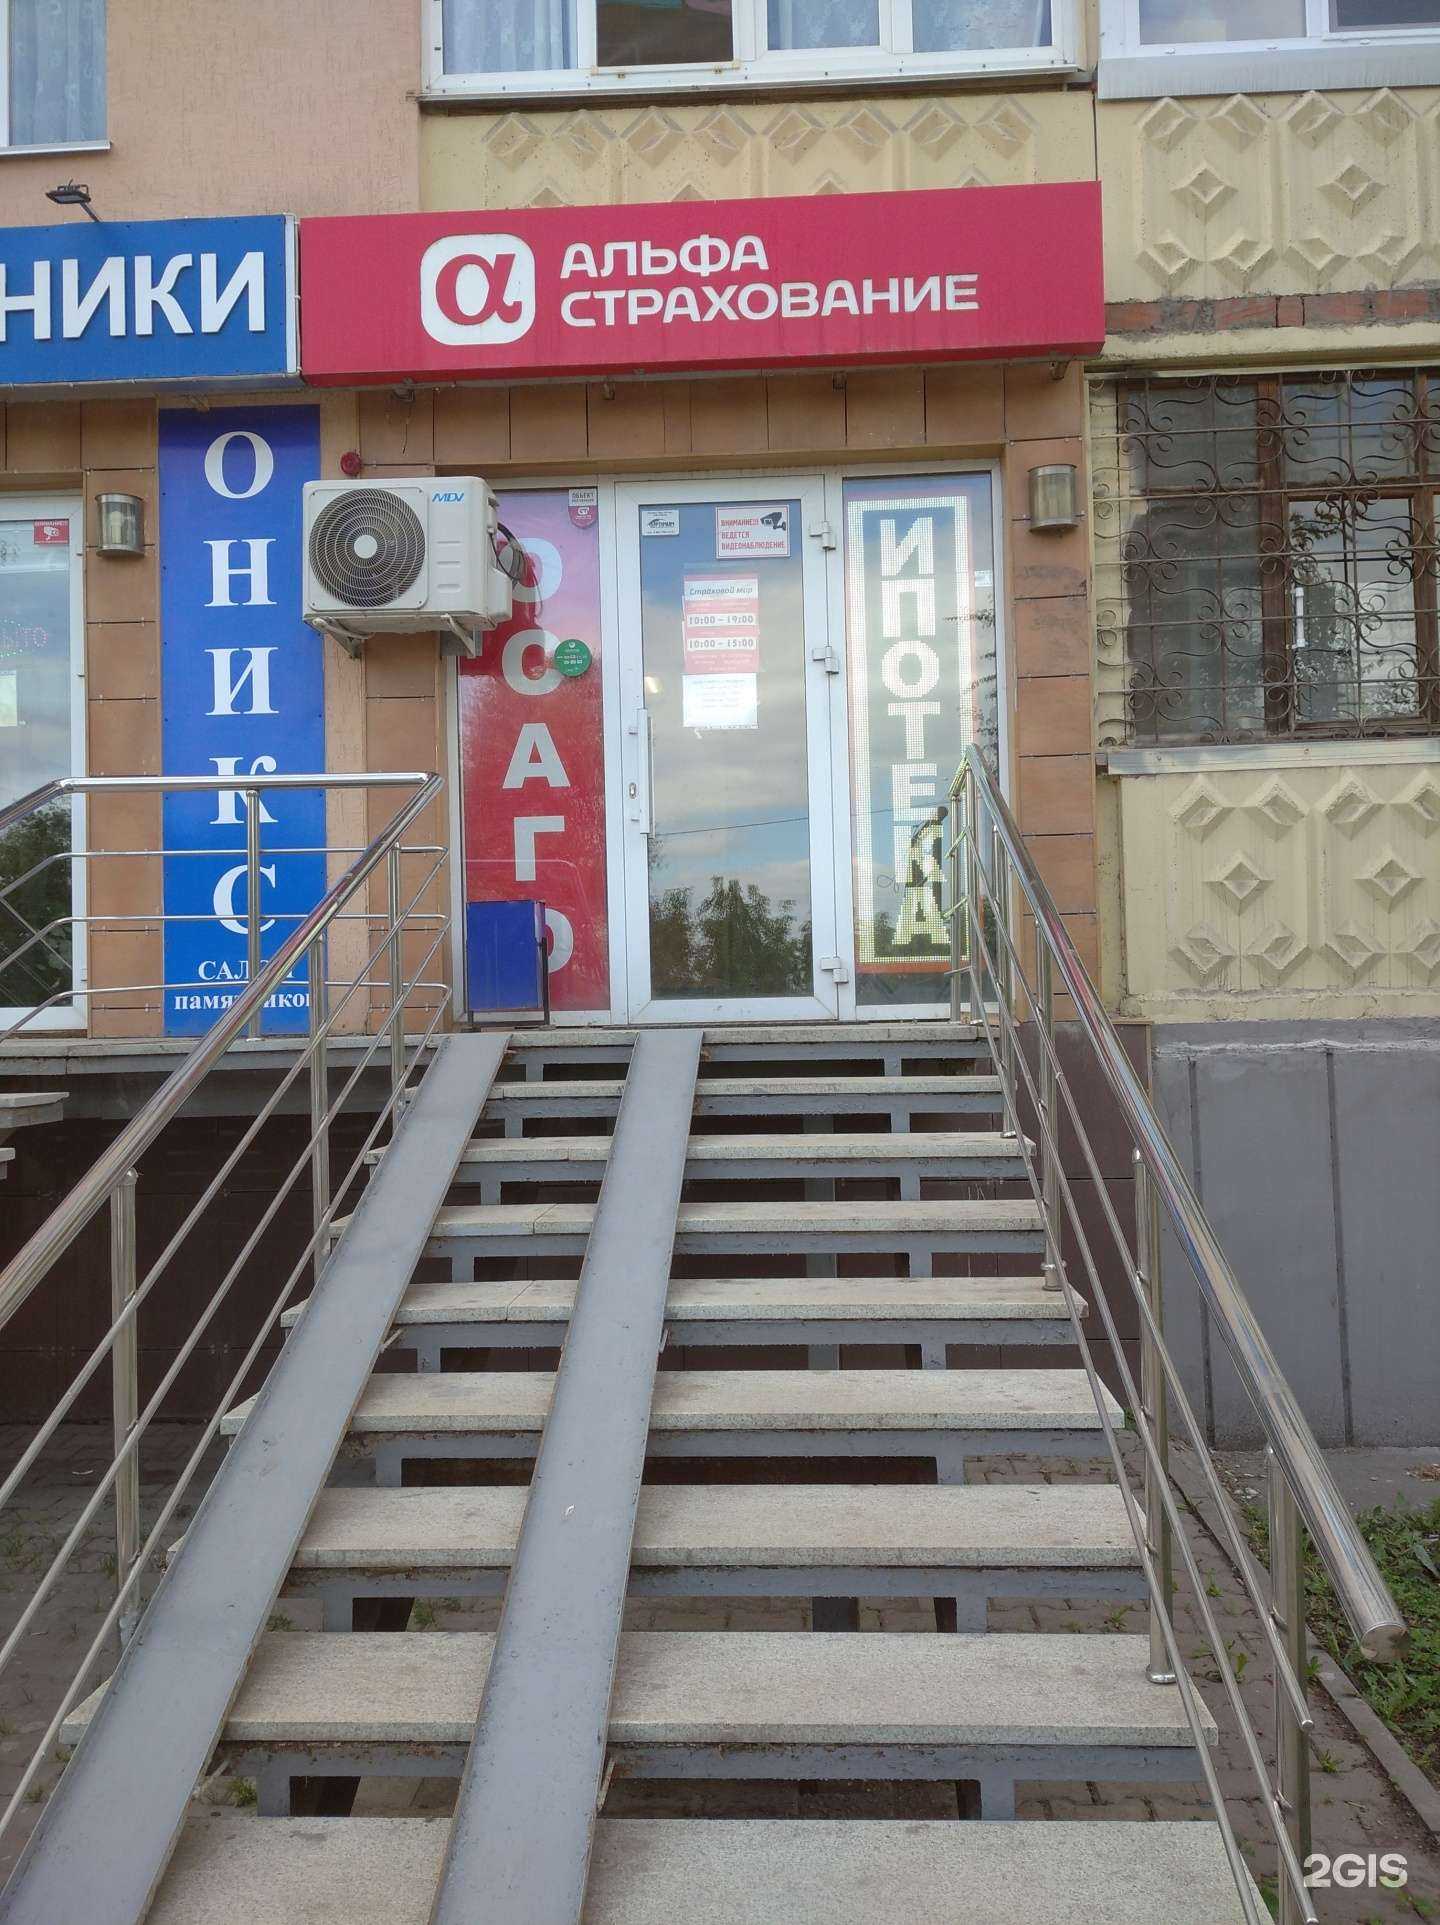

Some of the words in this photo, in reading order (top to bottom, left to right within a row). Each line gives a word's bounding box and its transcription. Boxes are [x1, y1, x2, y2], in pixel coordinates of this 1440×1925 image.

[559, 234, 770, 279] АЛЬФА
[0, 251, 266, 342] НИКИ
[560, 273, 980, 327] СТРАХОВАНИЕ
[432, 492, 465, 503] MDV
[689, 616, 716, 625] 10:00
[727, 615, 754, 623] 19:00
[689, 640, 716, 648] 10:00
[727, 639, 754, 647] 15:00
[203, 431, 279, 935] ОНИКС
[879, 516, 951, 945] ИПОТЕКА
[198, 959, 296, 981] САЛ
[174, 993, 310, 1010] памяико
